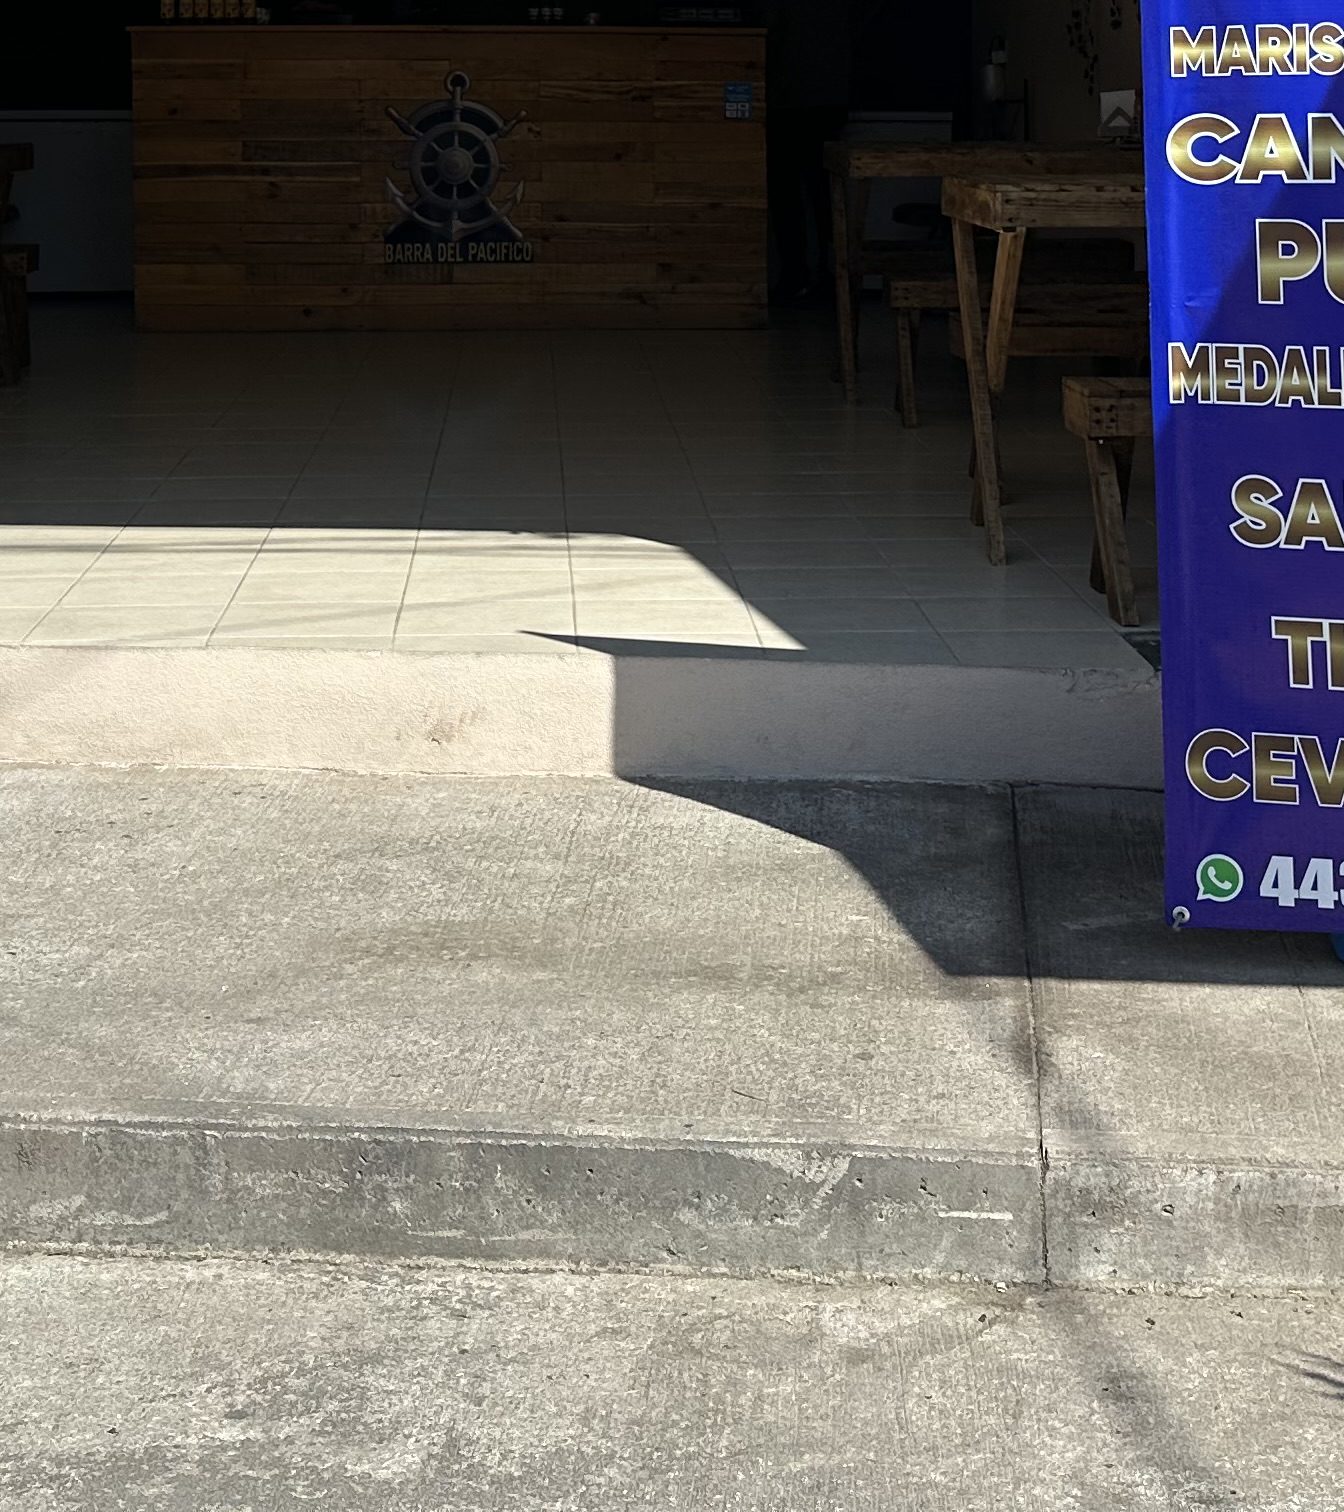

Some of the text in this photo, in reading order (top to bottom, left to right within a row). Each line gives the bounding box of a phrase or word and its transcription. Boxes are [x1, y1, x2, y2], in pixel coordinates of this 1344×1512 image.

[385, 241, 533, 263] BARRA DEL PACIFICO
